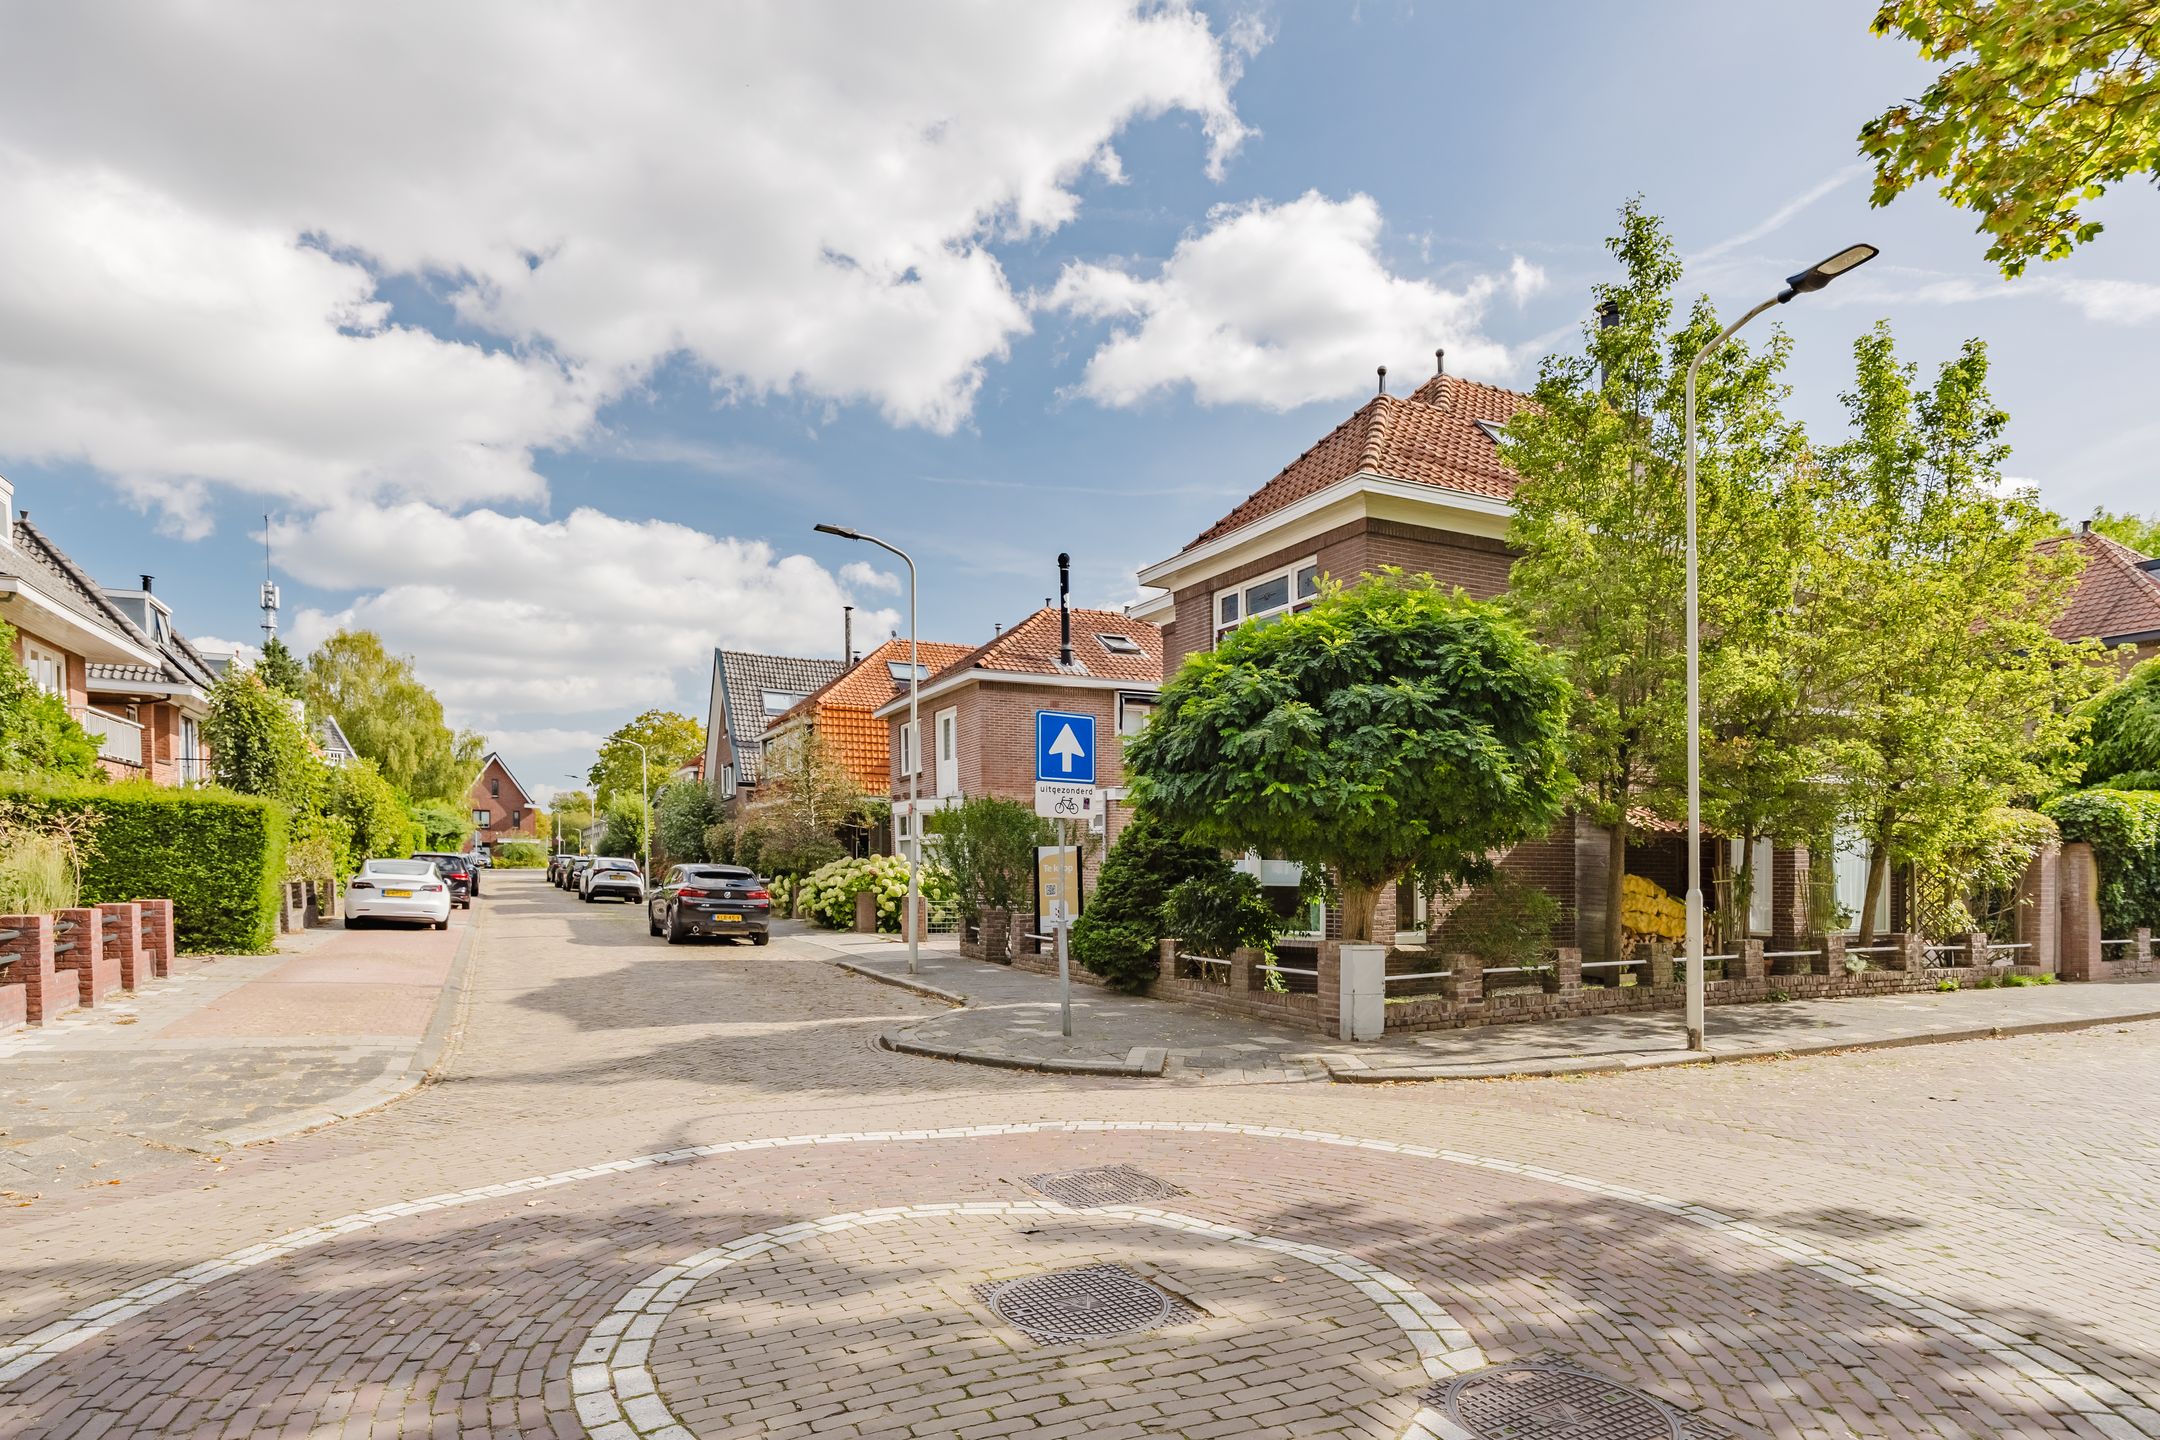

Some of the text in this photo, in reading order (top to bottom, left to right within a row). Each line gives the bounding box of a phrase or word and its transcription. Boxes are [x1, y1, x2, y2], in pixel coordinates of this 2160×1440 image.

[1040, 785, 1093, 795] uitgezonderd
[1043, 864, 1073, 874] Te kop
